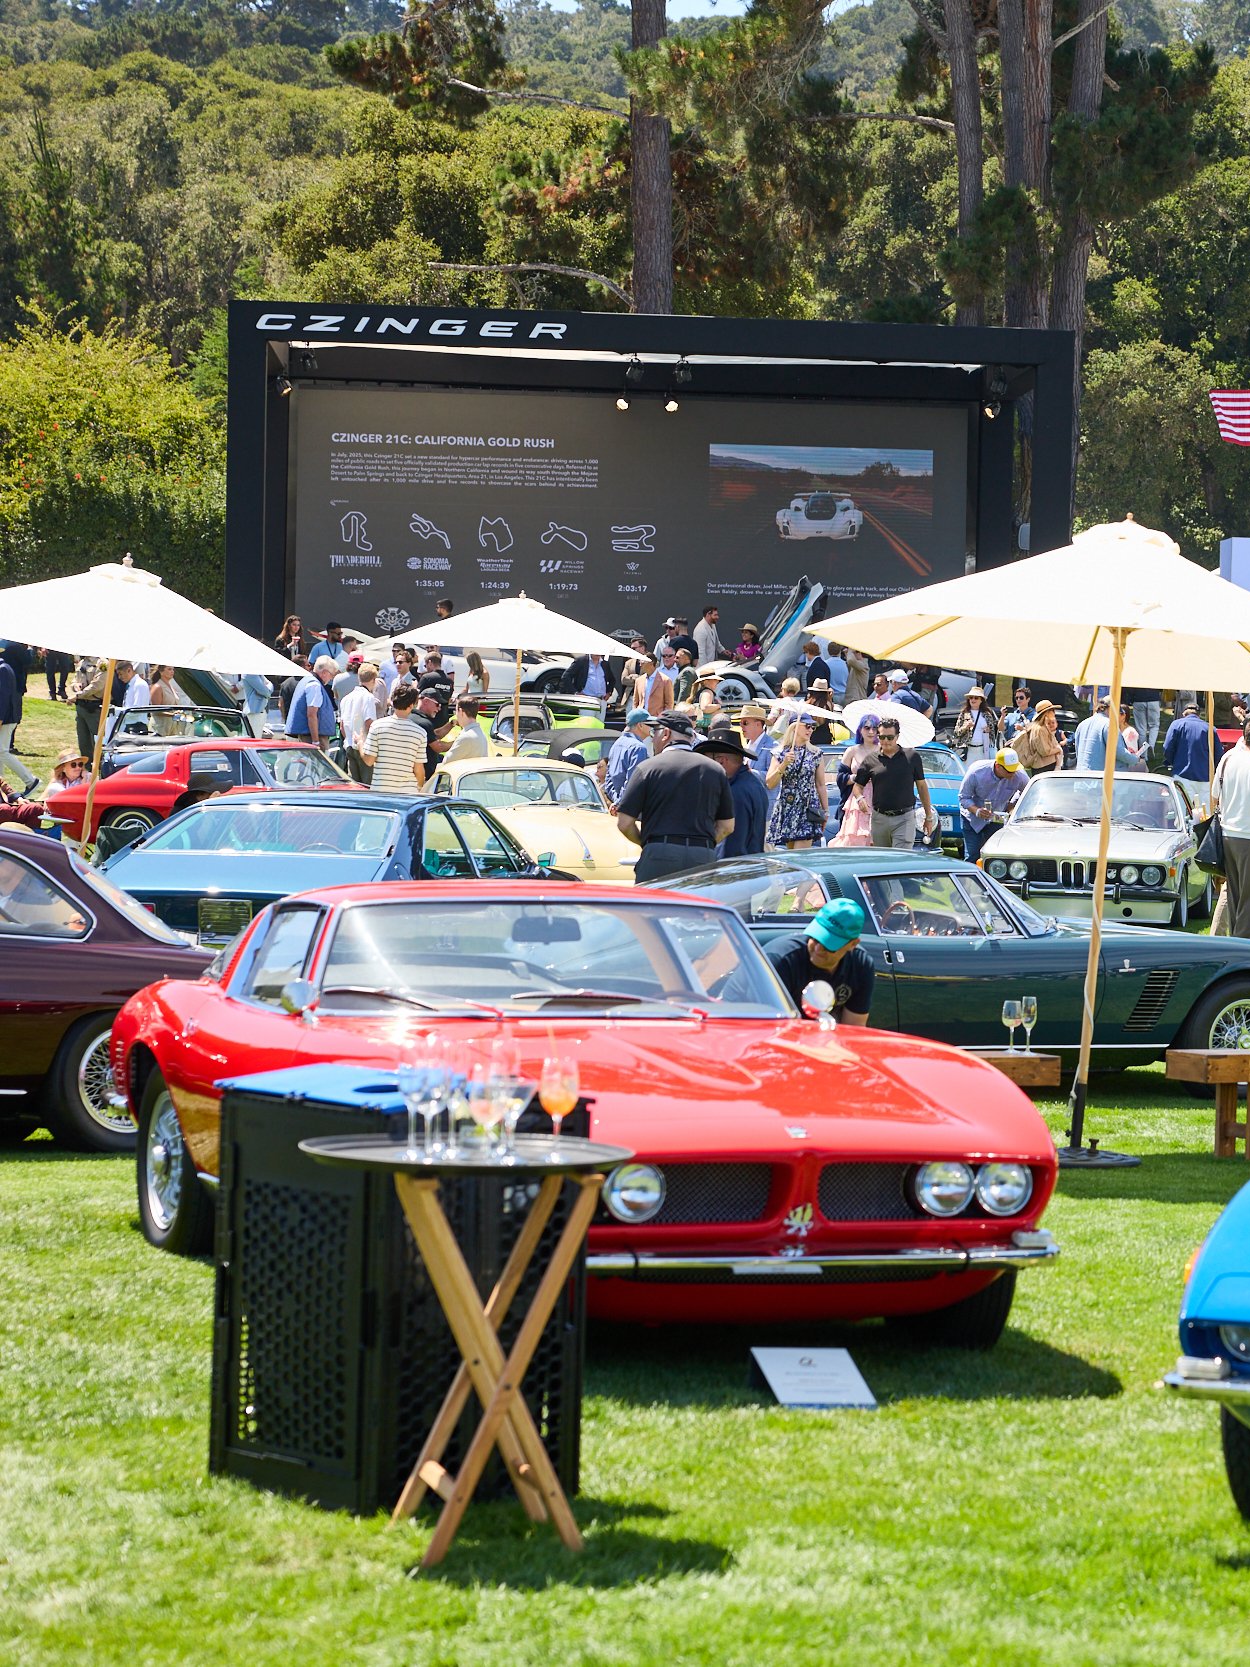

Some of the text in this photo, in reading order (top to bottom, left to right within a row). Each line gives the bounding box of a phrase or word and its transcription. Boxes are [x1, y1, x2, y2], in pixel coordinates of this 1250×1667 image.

[256, 314, 567, 339] CZINGER
[332, 433, 554, 448] CZINGER 21C: CALIFORNIA GOLD RUSH
[330, 555, 382, 567] THUNDERHILL
